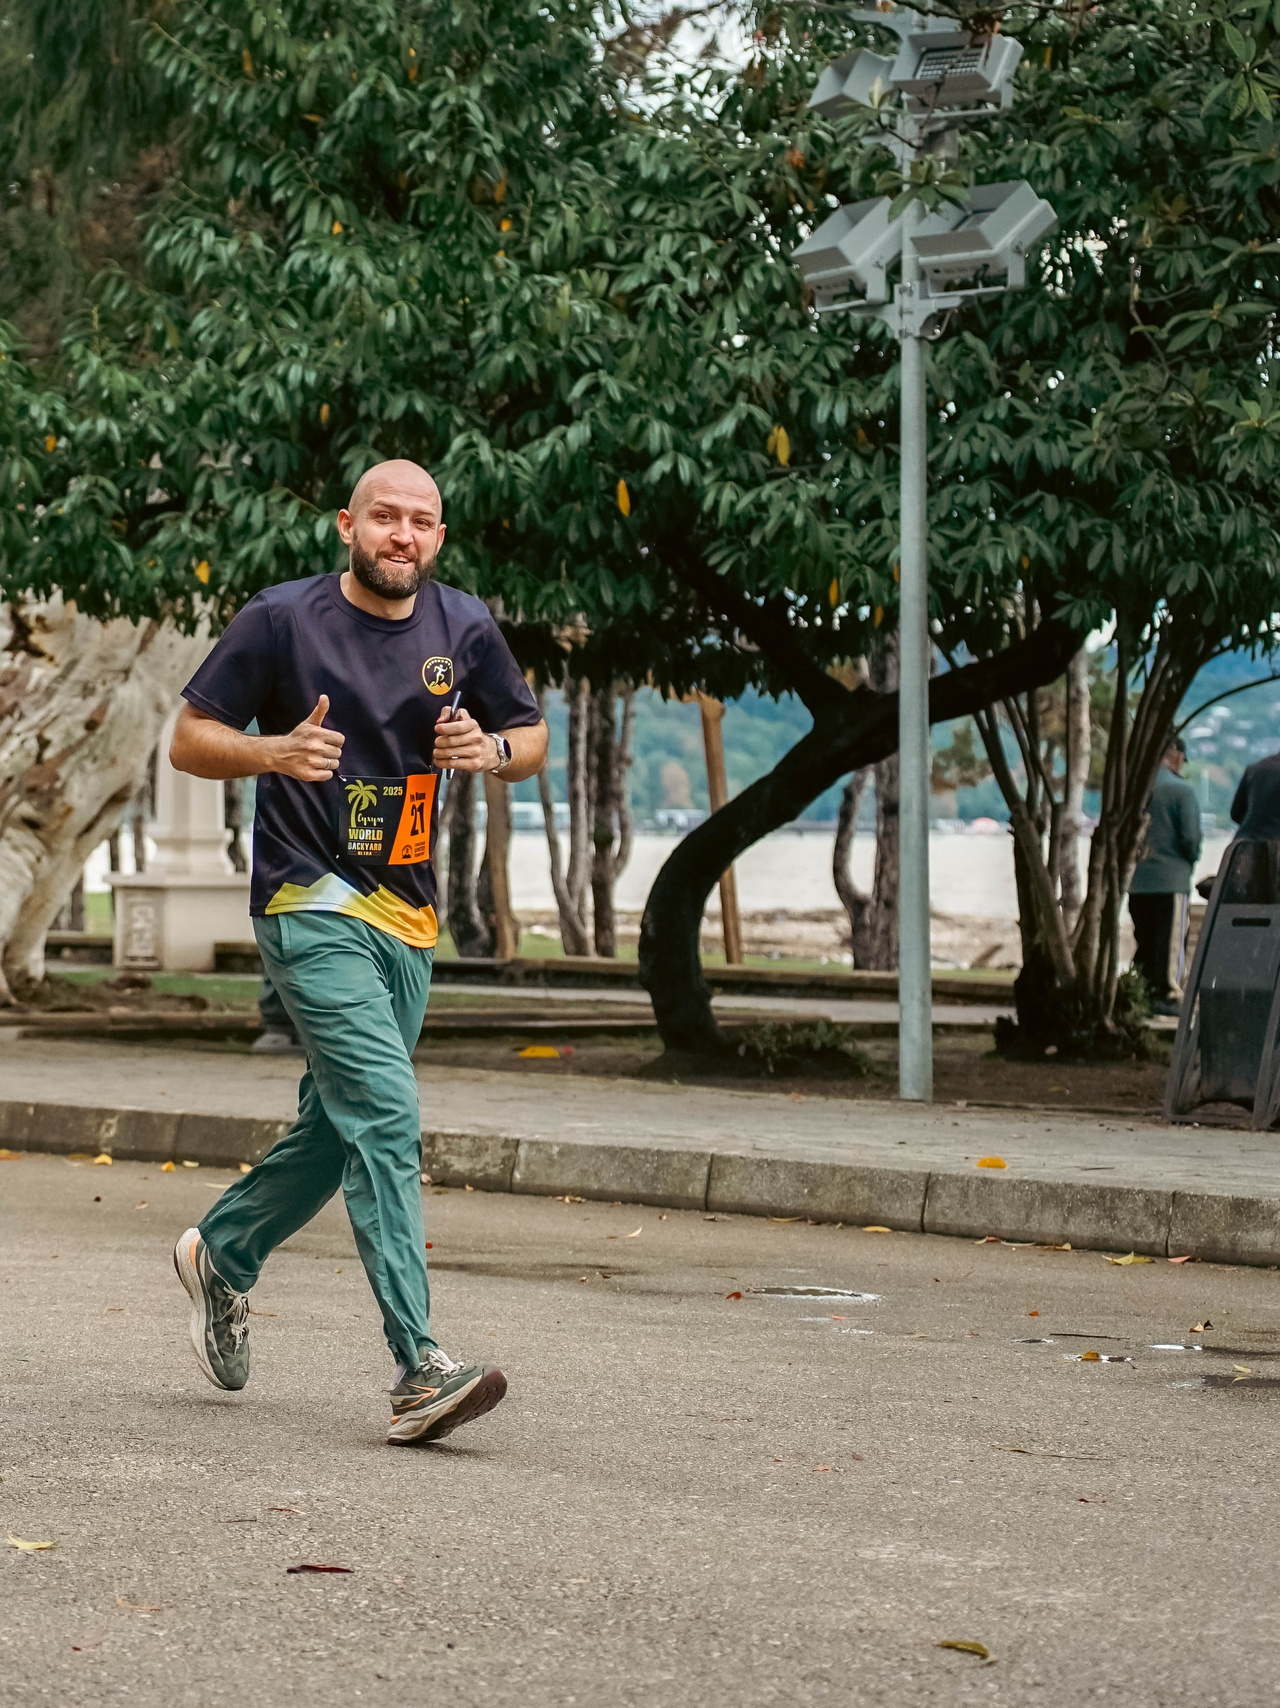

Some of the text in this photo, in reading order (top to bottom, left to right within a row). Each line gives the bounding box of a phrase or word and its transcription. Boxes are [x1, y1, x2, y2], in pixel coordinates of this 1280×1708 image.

[382, 786, 404, 796] 2025
[410, 801, 425, 836] 21
[348, 828, 383, 840] WORLD
[347, 842, 382, 851] BACKYARD
